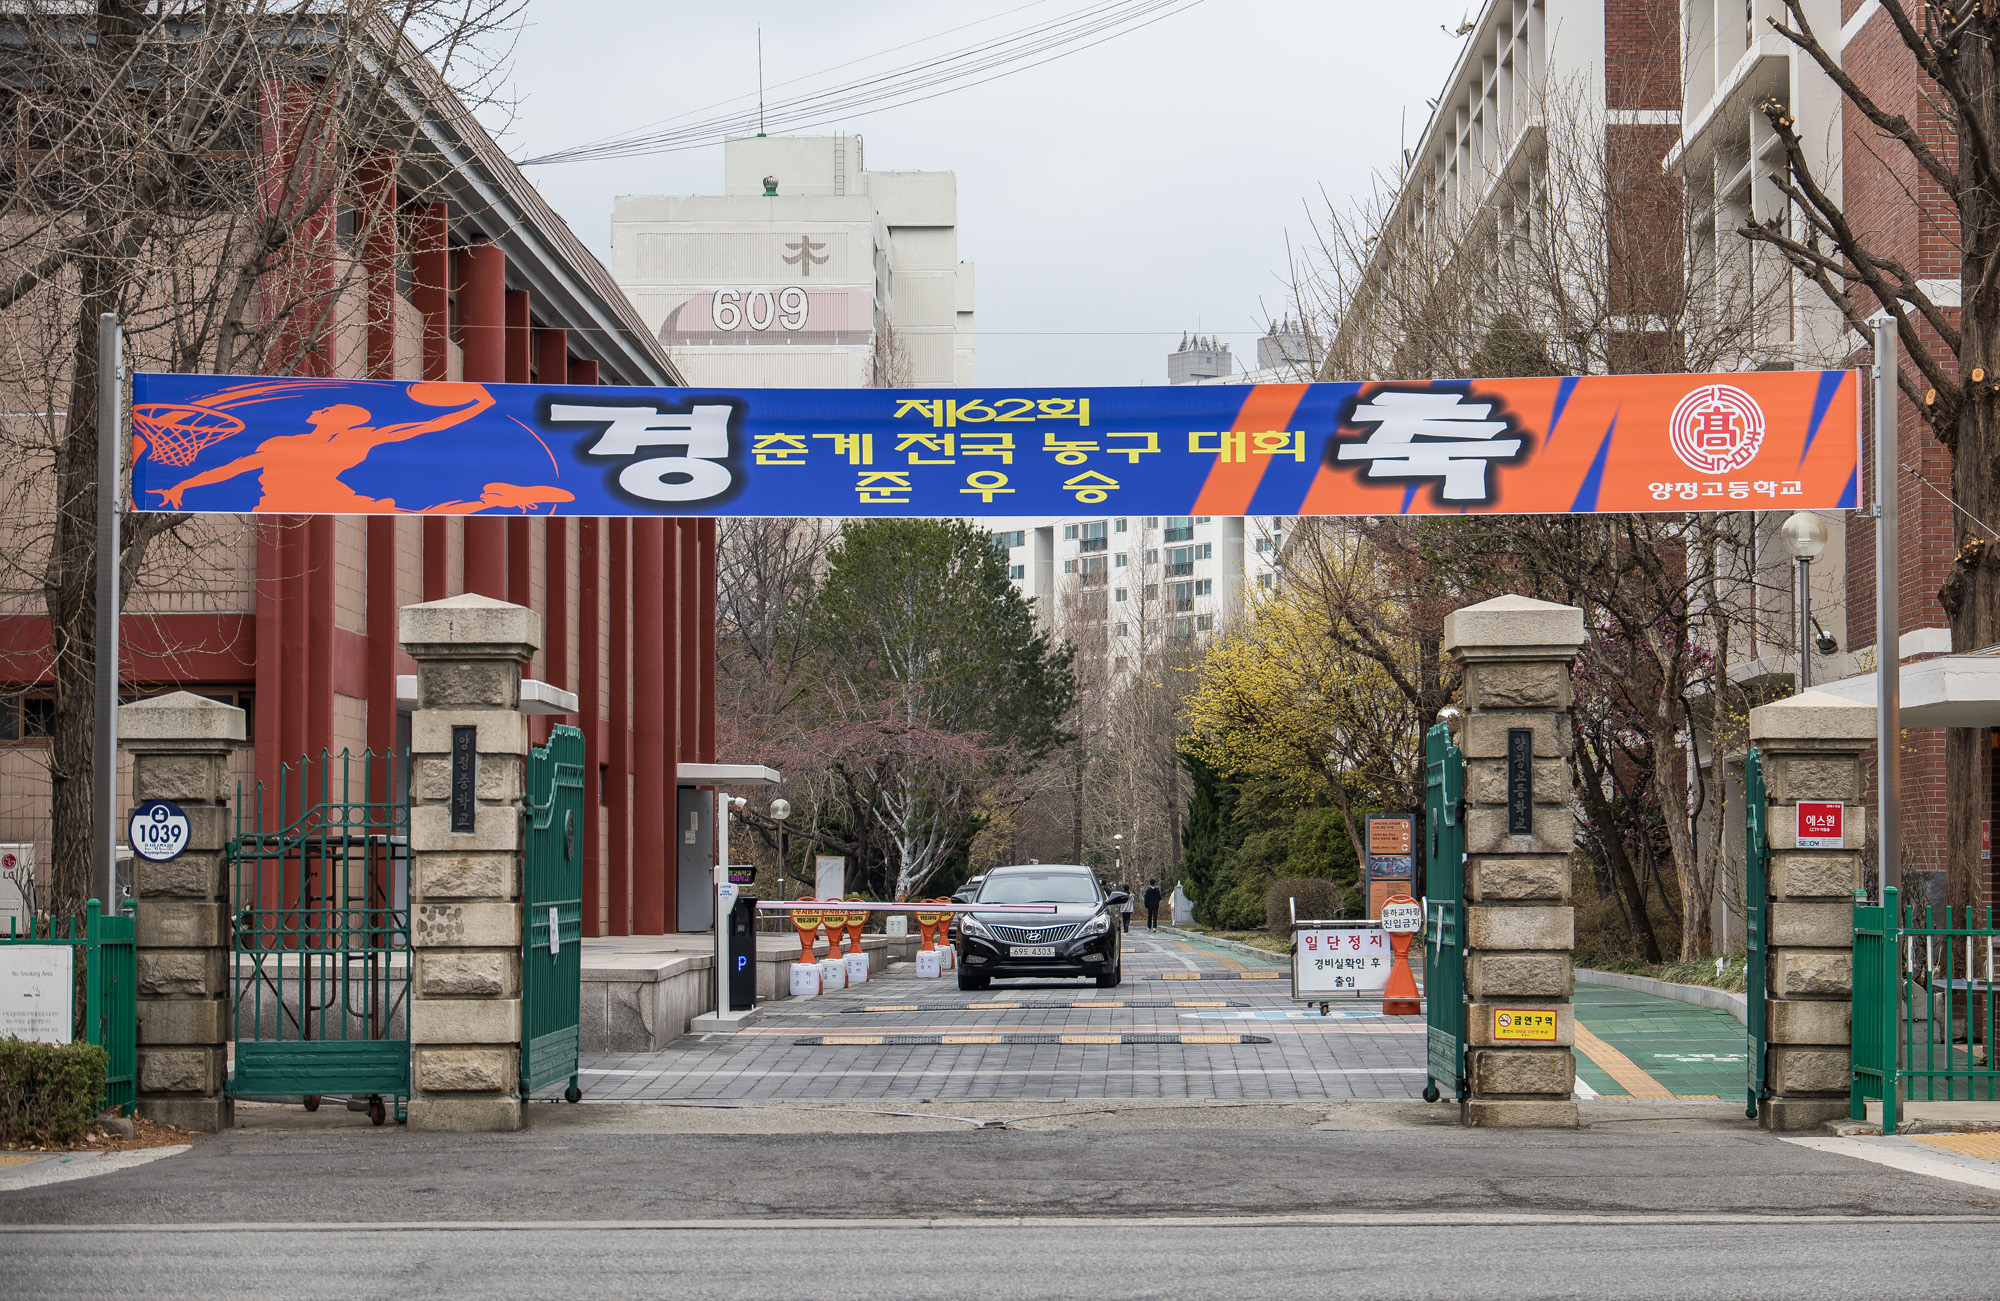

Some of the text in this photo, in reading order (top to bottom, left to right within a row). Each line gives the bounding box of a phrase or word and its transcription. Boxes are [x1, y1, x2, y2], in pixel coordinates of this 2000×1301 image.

[711, 286, 810, 332] 609
[893, 397, 1091, 428] 제62회
[549, 402, 733, 502] 경
[751, 430, 1306, 466] 춘계 전국 농구 대회
[1337, 391, 1522, 500] 축
[854, 469, 1121, 504] 준 우 승
[1648, 480, 1803, 501] 양정고등학교
[1513, 734, 1528, 830] 양정고등학교
[1806, 814, 1835, 827] 에스원
[139, 824, 182, 843] 1039
[1383, 908, 1421, 918] 등하교차량
[1383, 919, 1421, 929] 진입금지
[1032, 948, 1052, 956] 4303
[738, 956, 747, 972] P
[1314, 957, 1381, 970] 경비실확인 후
[1334, 975, 1355, 988] 출입
[1514, 1016, 1553, 1026] 금연구역
